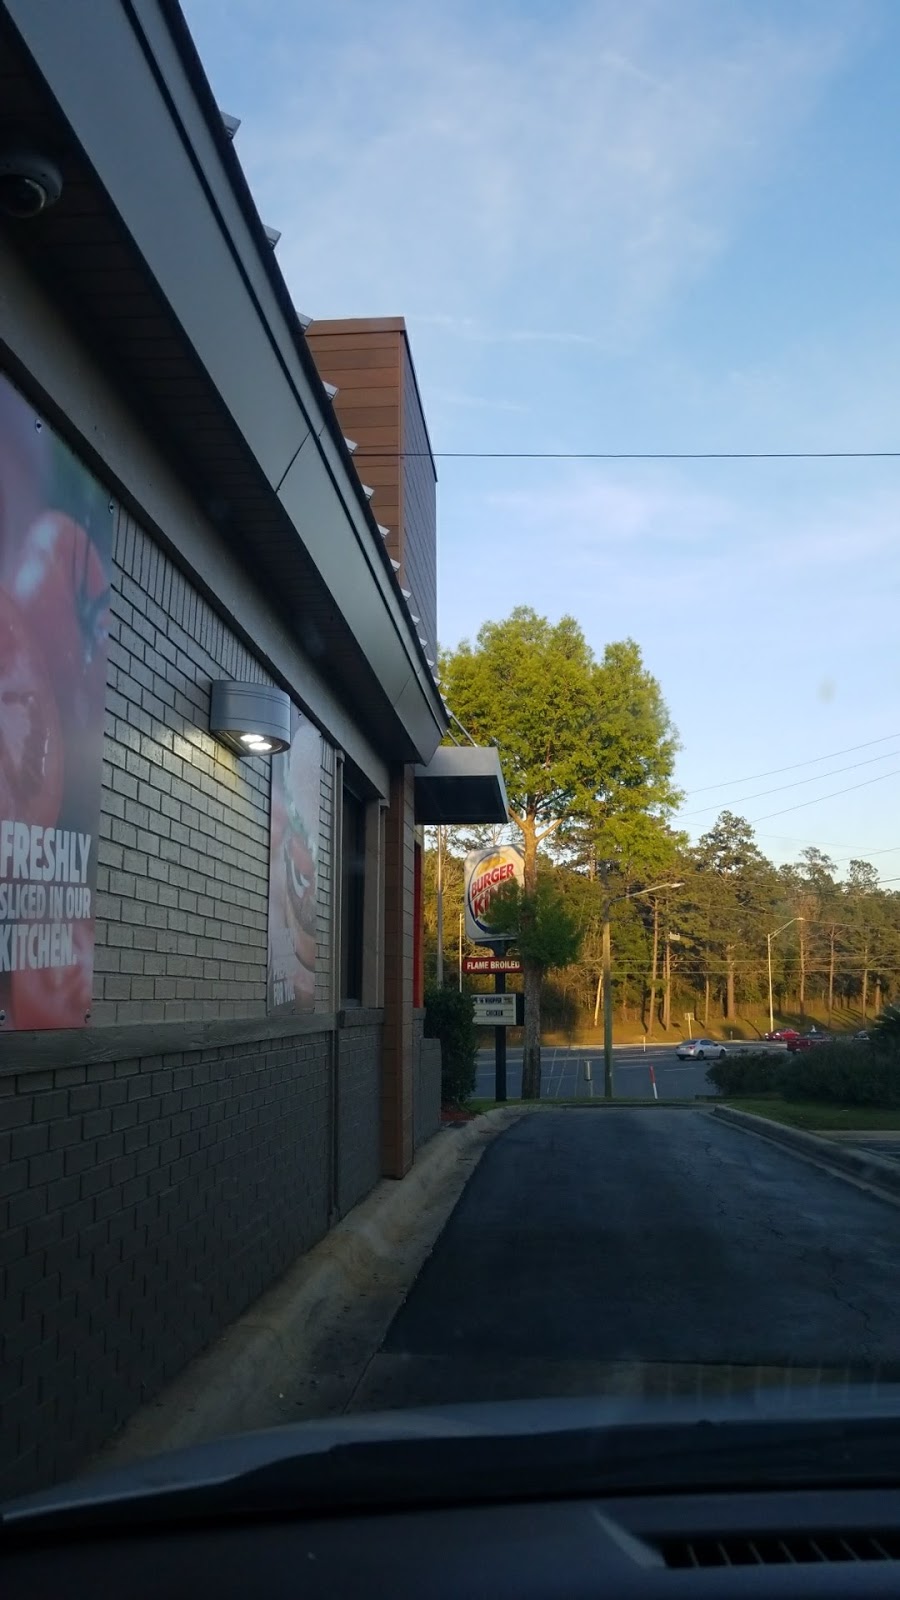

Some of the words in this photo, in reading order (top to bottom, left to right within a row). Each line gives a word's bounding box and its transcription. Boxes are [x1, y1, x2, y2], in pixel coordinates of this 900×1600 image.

[0, 820, 92, 884] FRESHLY
[471, 863, 515, 899] BURGER
[0, 883, 47, 920] SLICED
[49, 886, 64, 919] IN
[66, 887, 92, 919] OUR
[467, 961, 489, 970] FLAME
[490, 960, 521, 969] BROILED
